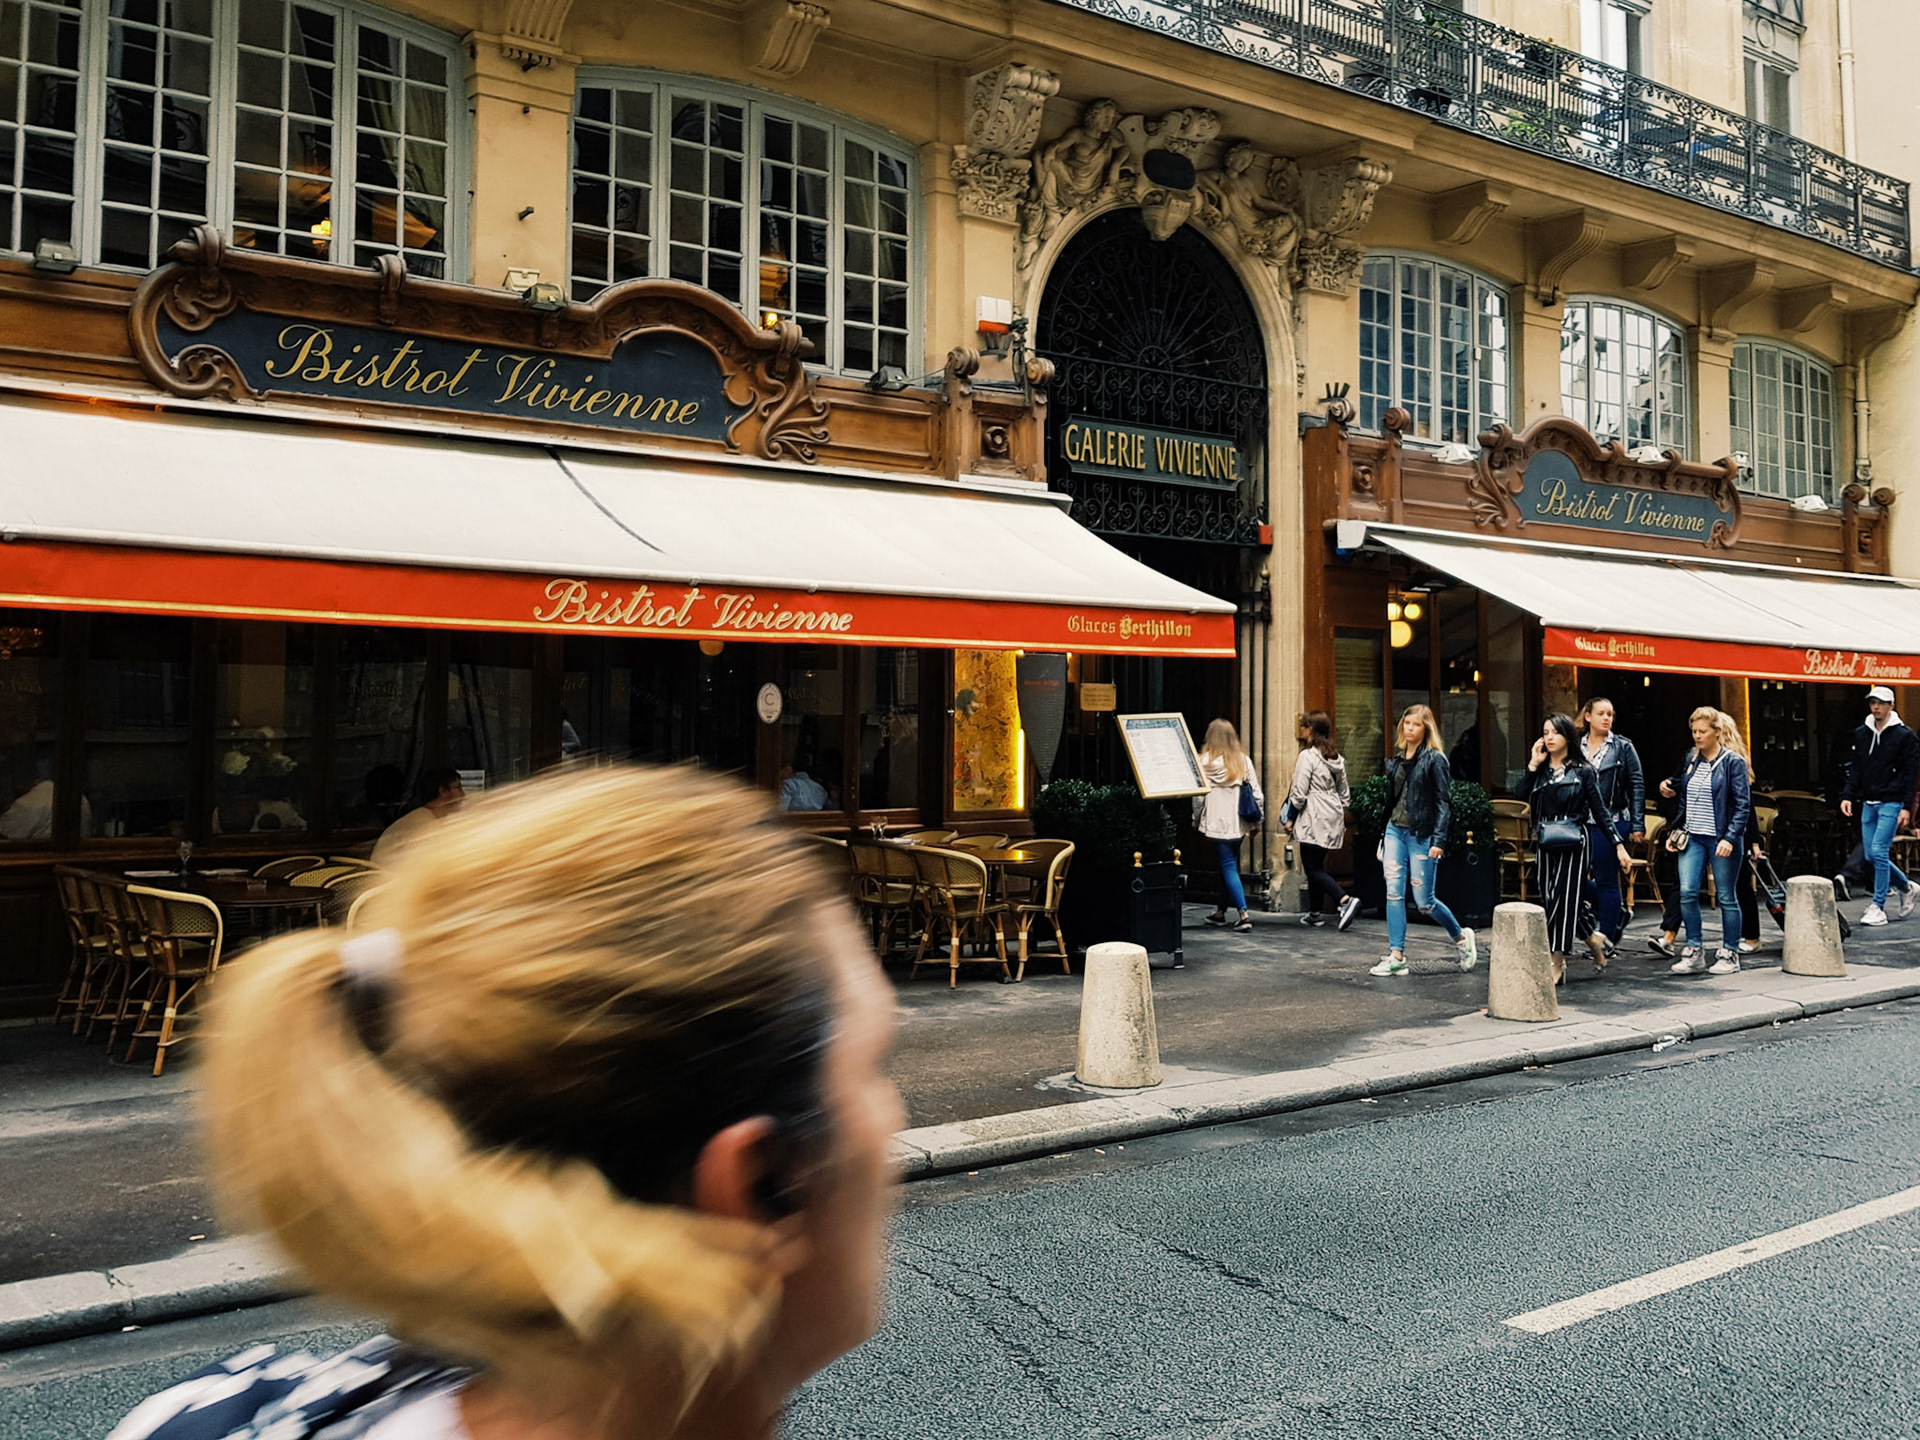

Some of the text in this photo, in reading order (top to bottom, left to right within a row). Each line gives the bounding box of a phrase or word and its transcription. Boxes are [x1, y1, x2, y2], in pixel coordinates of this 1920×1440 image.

[265, 324, 699, 424] Bistrot Vivienne
[1065, 424, 1237, 480] GALERIE VIVIENNE
[1536, 478, 1705, 532] Bistrot Vivienne
[533, 578, 853, 632] Bistrot Vivienne
[1067, 614, 1192, 641] Glaces Berthillon
[1574, 636, 1607, 652] Glaces
[1803, 649, 1912, 678] Bistrot Vivienne
